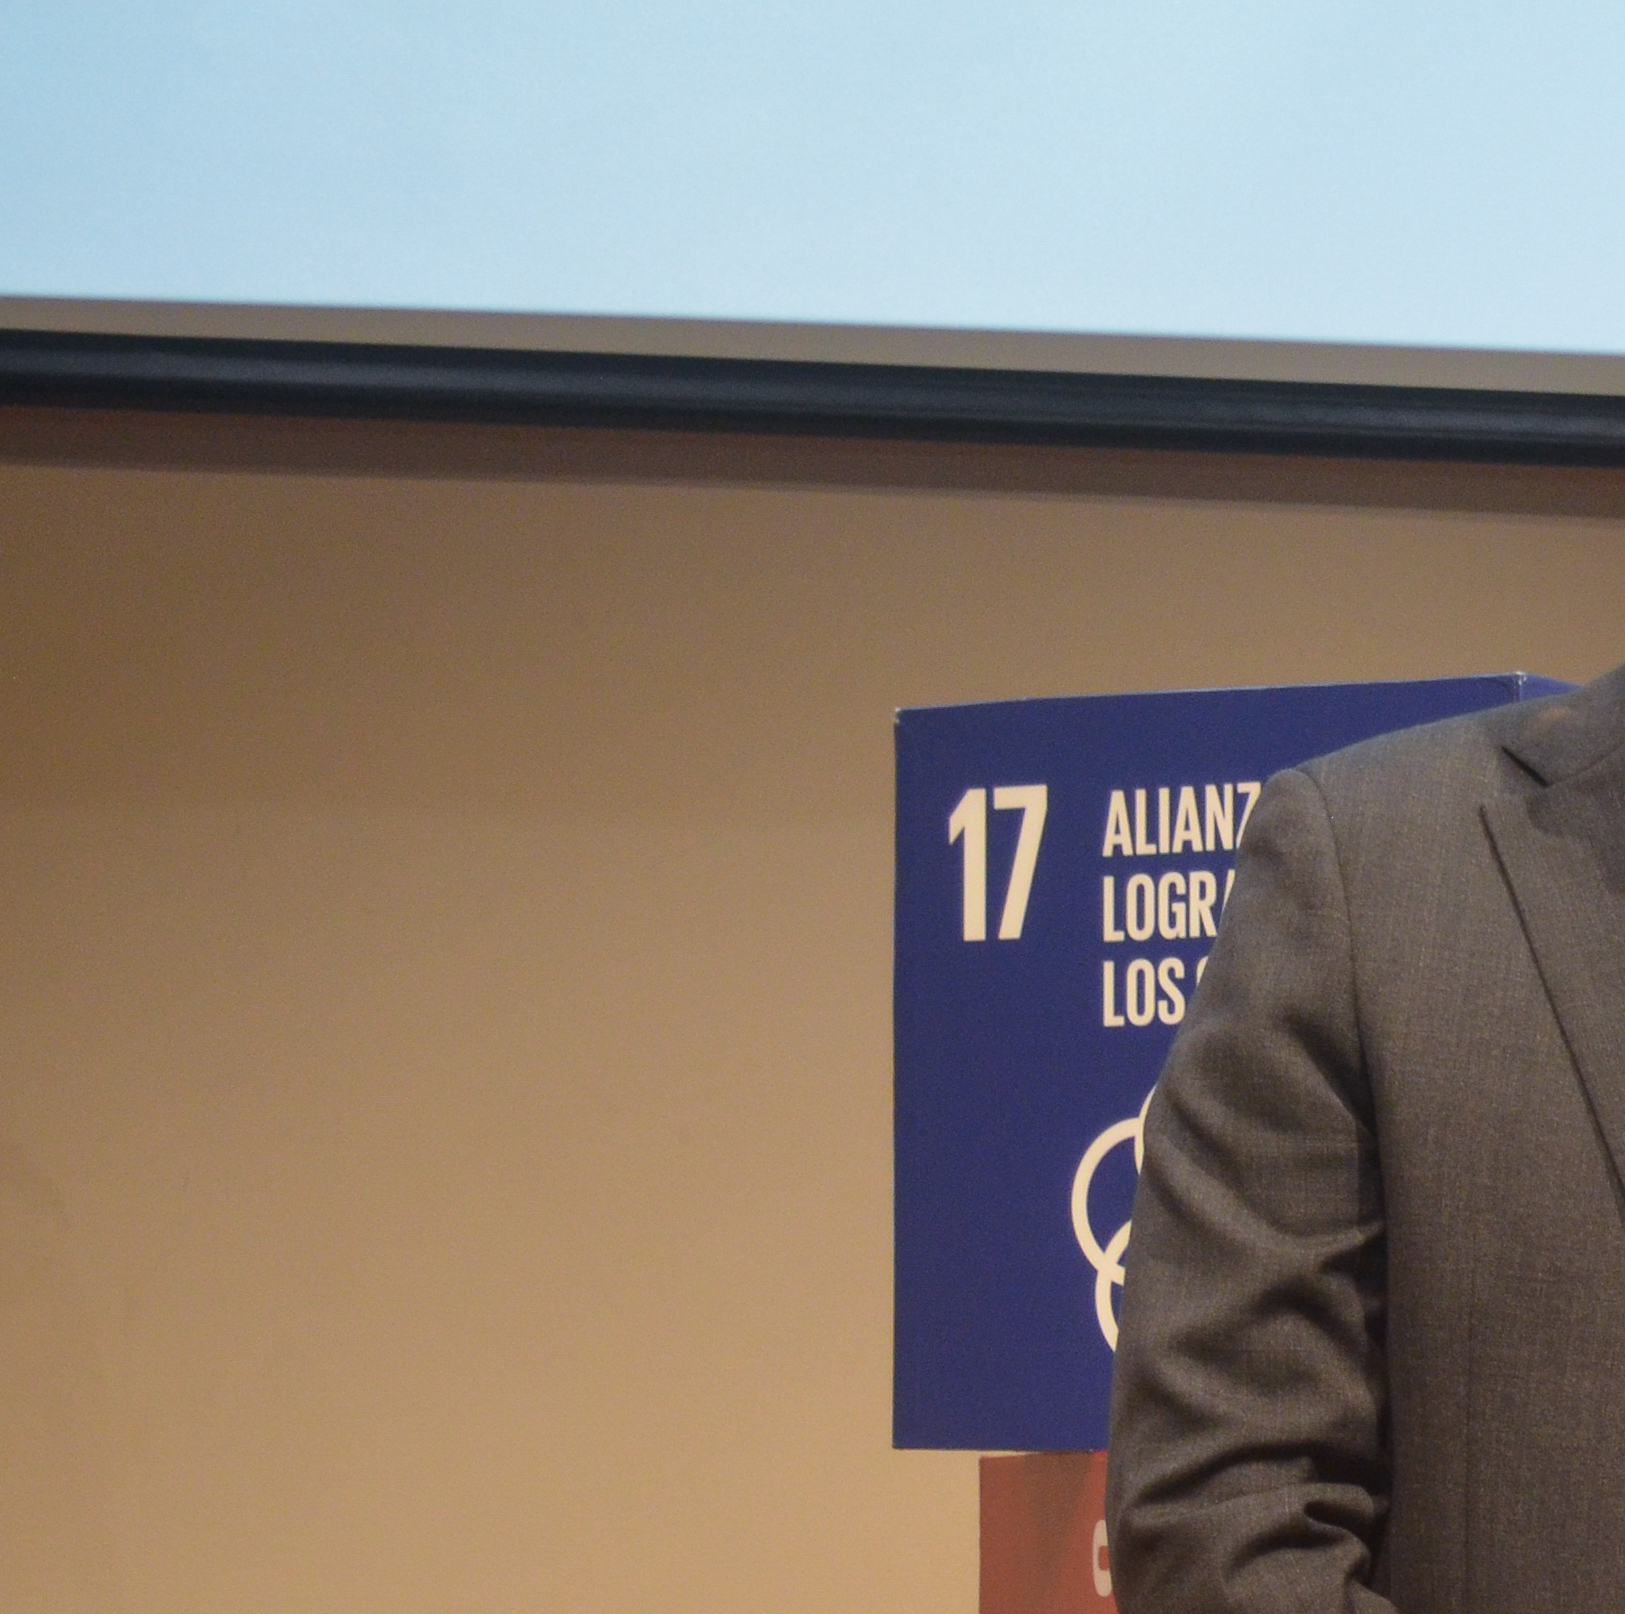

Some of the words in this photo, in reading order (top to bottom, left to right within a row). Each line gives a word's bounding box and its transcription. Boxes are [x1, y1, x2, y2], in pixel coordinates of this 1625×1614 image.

[948, 784, 1048, 942] 17
[1103, 869, 1235, 942] LOGR
[1103, 957, 1185, 1027] LOS
